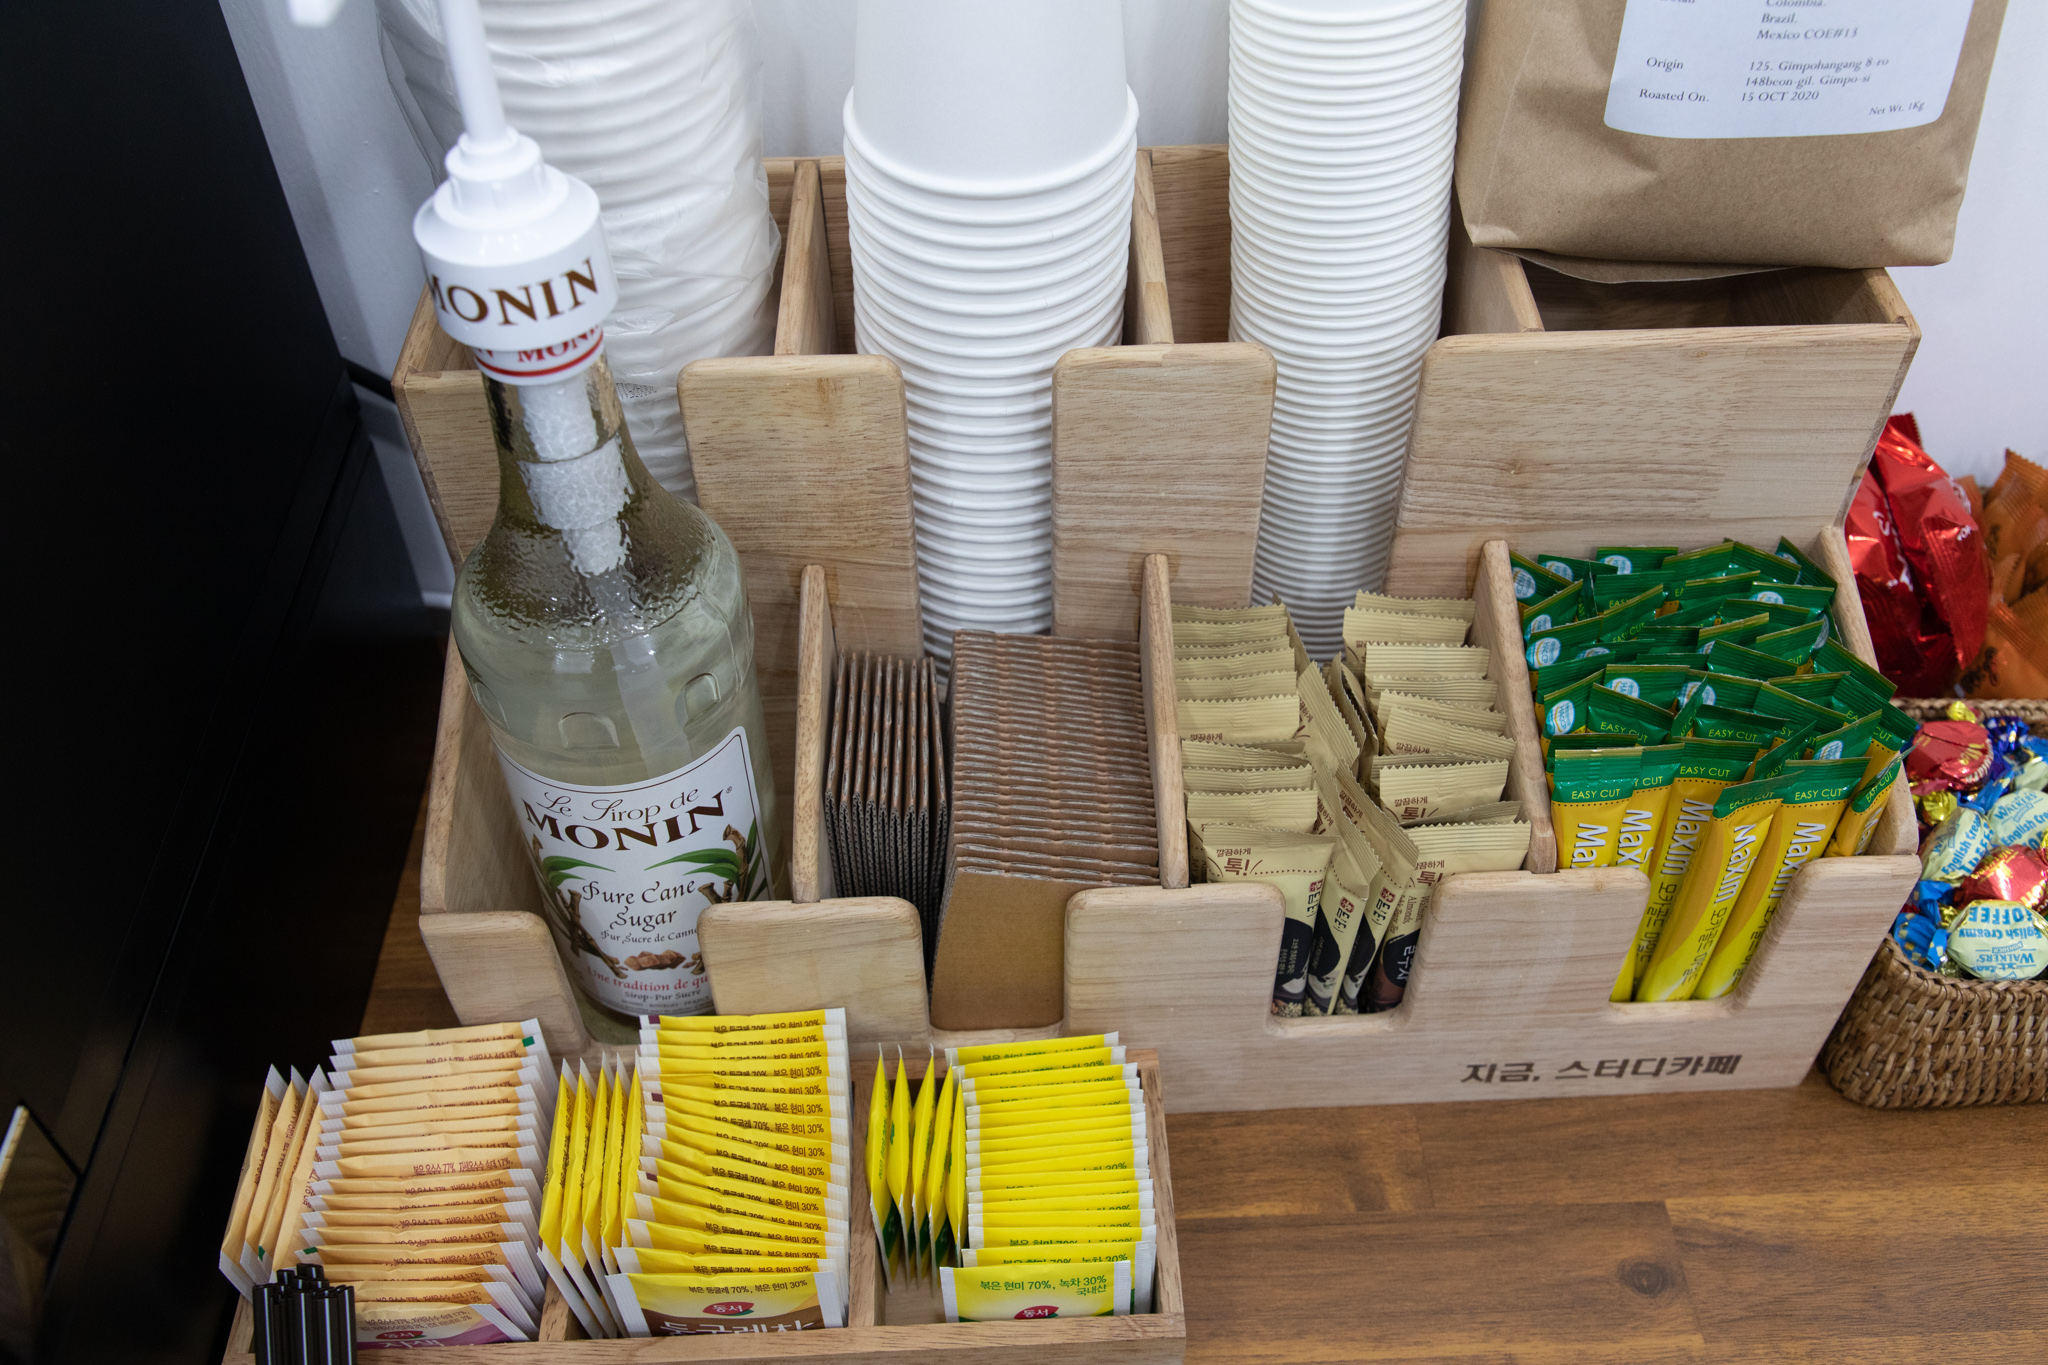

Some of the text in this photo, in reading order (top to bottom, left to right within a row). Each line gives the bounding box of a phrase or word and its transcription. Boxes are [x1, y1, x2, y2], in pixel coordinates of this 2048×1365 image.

[1756, 30, 1800, 40] Mexico
[1646, 57, 1684, 73] Origin
[1778, 60, 1862, 73] Gimpohangang
[1819, 73, 1871, 87] Gimpo-si
[1639, 88, 1685, 101] Roasted
[1742, 90, 1820, 102] 15 OCT 2020
[1869, 106, 1885, 115] Net
[1600, 721, 1627, 735] EASY
[1708, 729, 1757, 742] EASY CUT
[1680, 766, 1731, 778] EASY CUT
[1571, 788, 1621, 800] EASY CUT
[1795, 788, 1842, 801] EASY CUT
[536, 788, 699, 824] Le Sirop de
[1394, 796, 1428, 807] 깔끔하게
[521, 788, 726, 851] MONIN
[1660, 798, 1714, 875] Maxim
[1216, 848, 1252, 858] 깔끔하게
[1224, 857, 1250, 877] 톡!
[1713, 823, 1757, 904] Maxim
[582, 880, 696, 905] Pure Cane
[609, 905, 677, 932] Sugar
[622, 933, 652, 945] Sucre
[654, 934, 665, 943] de
[1959, 928, 2003, 940] Creamy
[613, 978, 670, 992] tradition
[674, 978, 689, 990] de
[806, 1066, 822, 1075] 30%
[1554, 1054, 1743, 1080] 스터디카페
[790, 1103, 805, 1114] 현미
[806, 1104, 823, 1114] 30%
[791, 1123, 805, 1134] 현미
[807, 1123, 824, 1133] 30%
[792, 1146, 806, 1157] 현미
[808, 1148, 825, 1157] 30%
[807, 1167, 824, 1176] 30%
[804, 1186, 821, 1195] 30%
[785, 1200, 799, 1211] 현미
[801, 1202, 818, 1211] 30%
[772, 1282, 788, 1290] 현미
[789, 1280, 808, 1289] 30%
[980, 1280, 1001, 1291] 볶은
[1004, 1281, 1025, 1291] 현미
[1059, 1277, 1081, 1288] 녹차
[1083, 1274, 1107, 1287] 30%
[1076, 1284, 1107, 1296] 국내산
[713, 1305, 743, 1313] 동서
[1023, 1308, 1049, 1317] 동서
